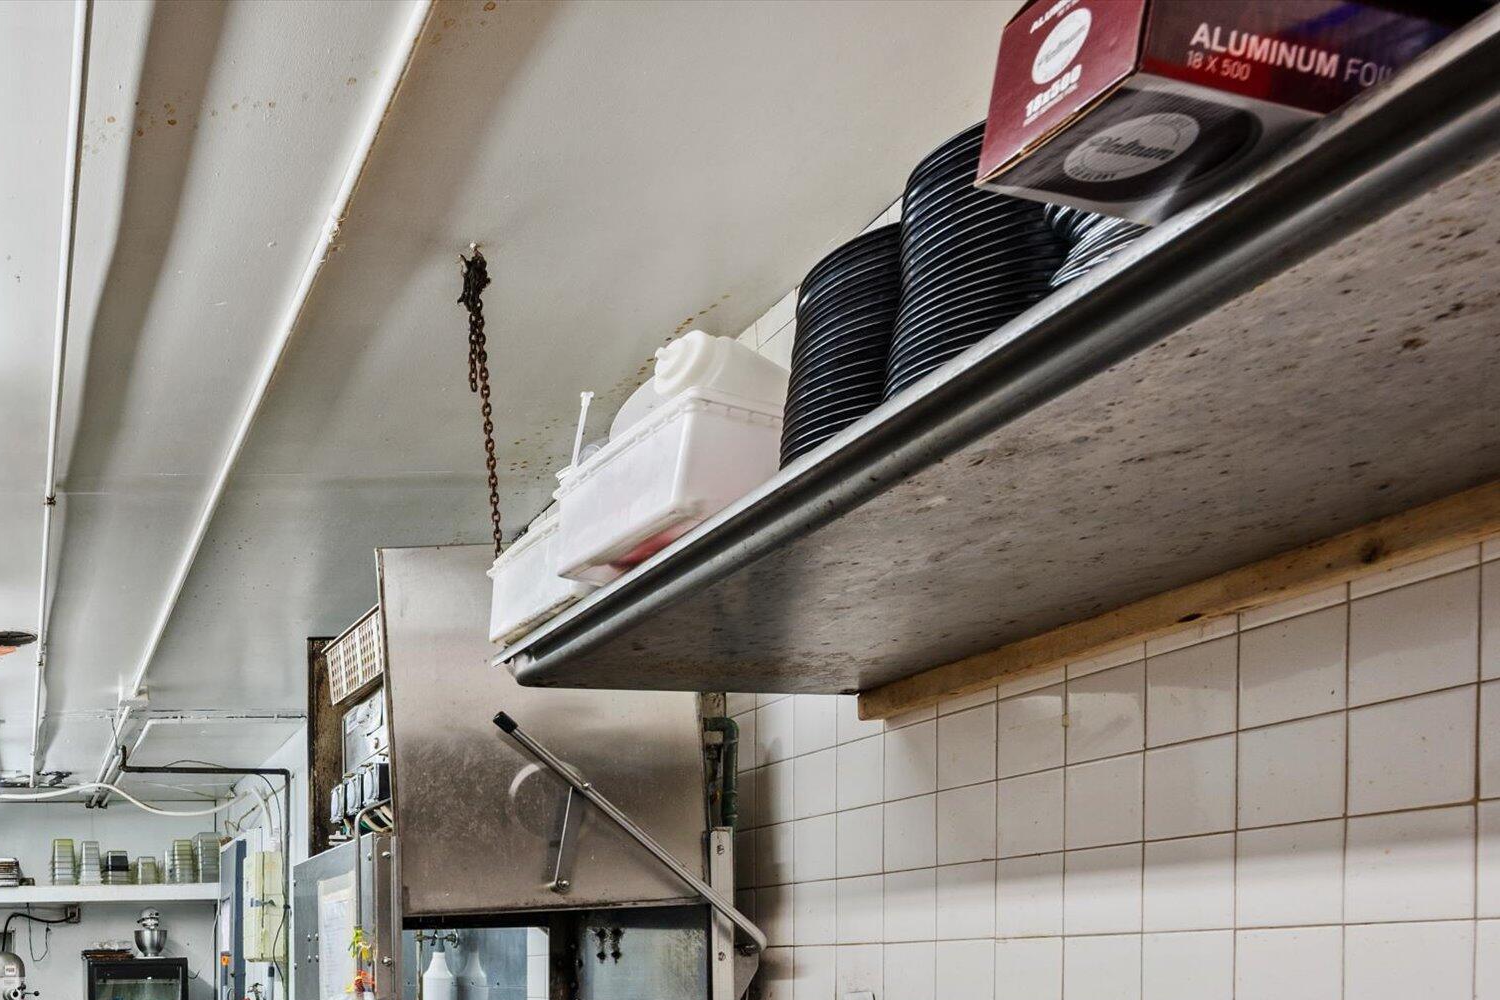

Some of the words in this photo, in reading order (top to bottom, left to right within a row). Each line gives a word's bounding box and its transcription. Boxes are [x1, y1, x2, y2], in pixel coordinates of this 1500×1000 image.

[1186, 51, 1203, 70] 18
[1220, 59, 1251, 82] 500
[1190, 22, 1340, 78] ALUMINUM
